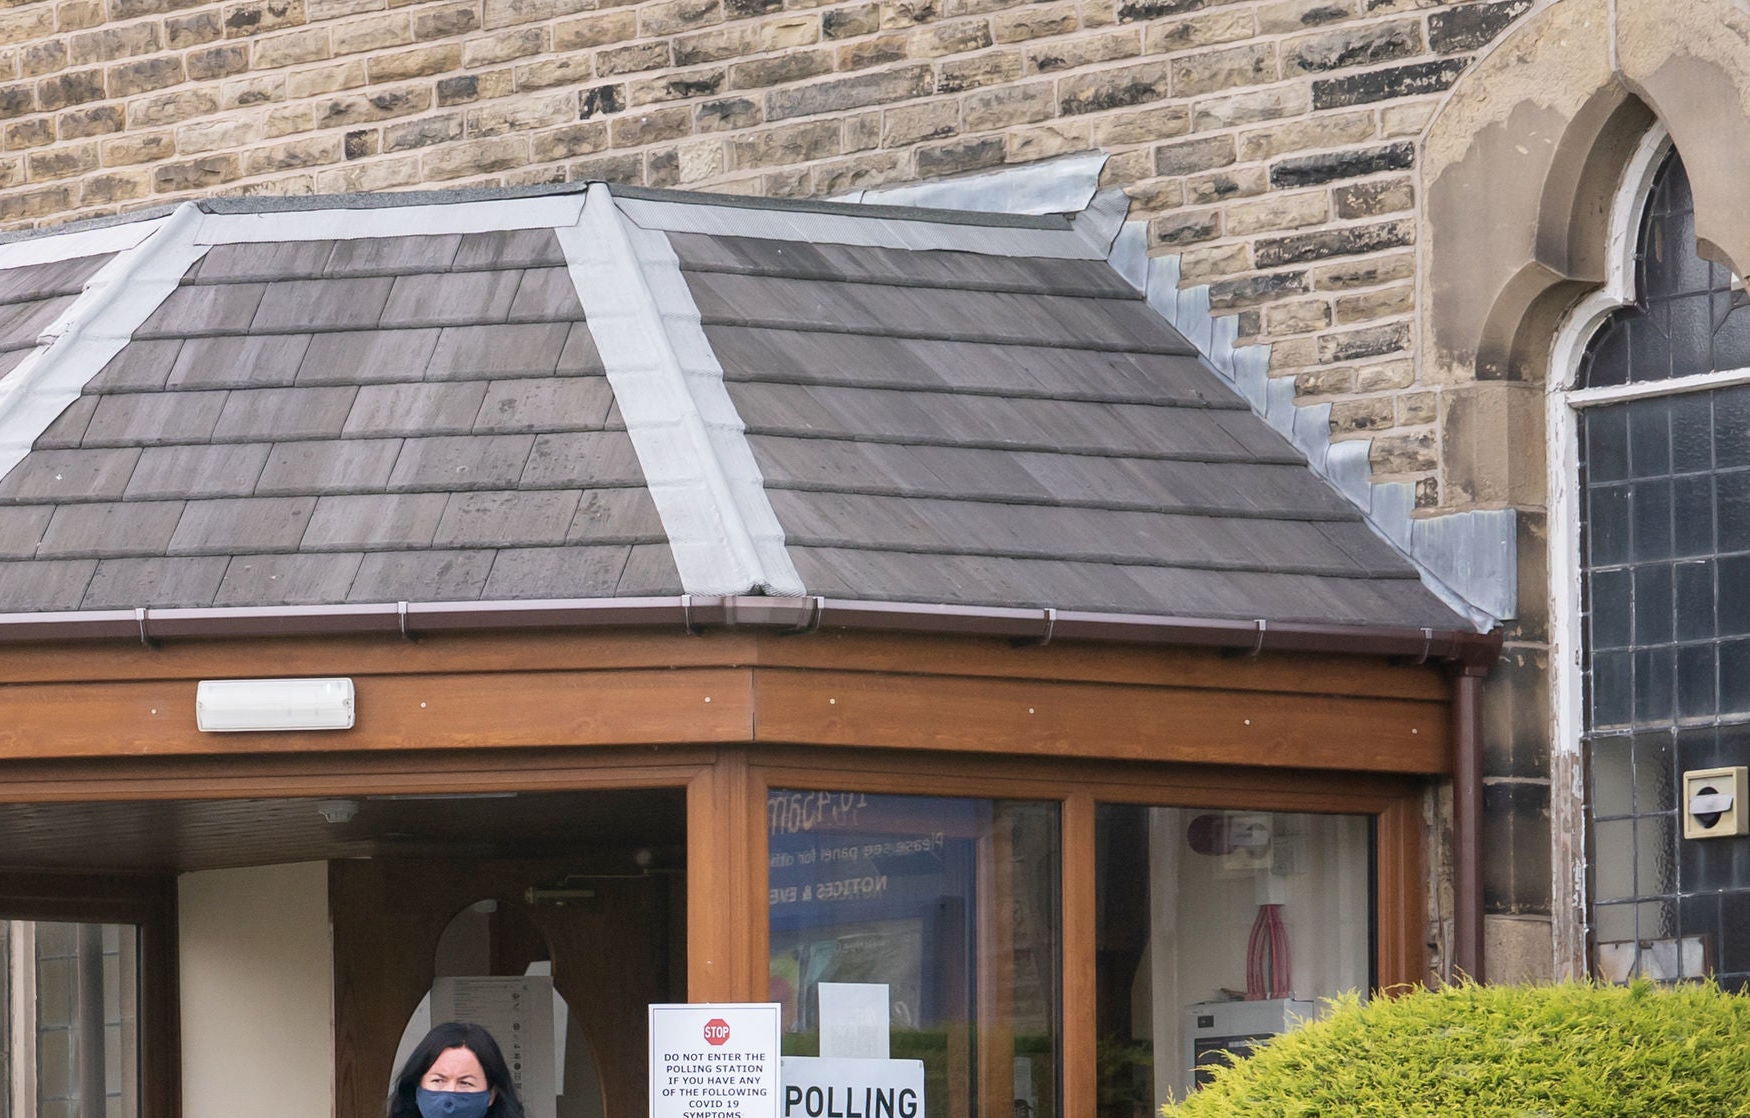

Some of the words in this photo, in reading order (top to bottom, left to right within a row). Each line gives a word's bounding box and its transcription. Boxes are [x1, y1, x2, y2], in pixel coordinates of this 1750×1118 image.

[705, 1026, 729, 1038] STOP
[664, 1053, 679, 1061] DO
[683, 1053, 704, 1061] NOT
[708, 1053, 741, 1061] ENTER
[745, 1053, 765, 1061] THE
[666, 1065, 712, 1073] POLLING
[715, 1065, 763, 1073] STATION
[668, 1077, 679, 1085] IF
[683, 1077, 704, 1085] YOU
[707, 1077, 735, 1085] HAVE
[739, 1077, 761, 1085] ANY
[662, 1088, 676, 1097] OF
[679, 1088, 699, 1097] THE
[702, 1088, 767, 1097] FOLLOWING
[689, 1100, 723, 1108] COVID
[728, 1100, 739, 1108] 19
